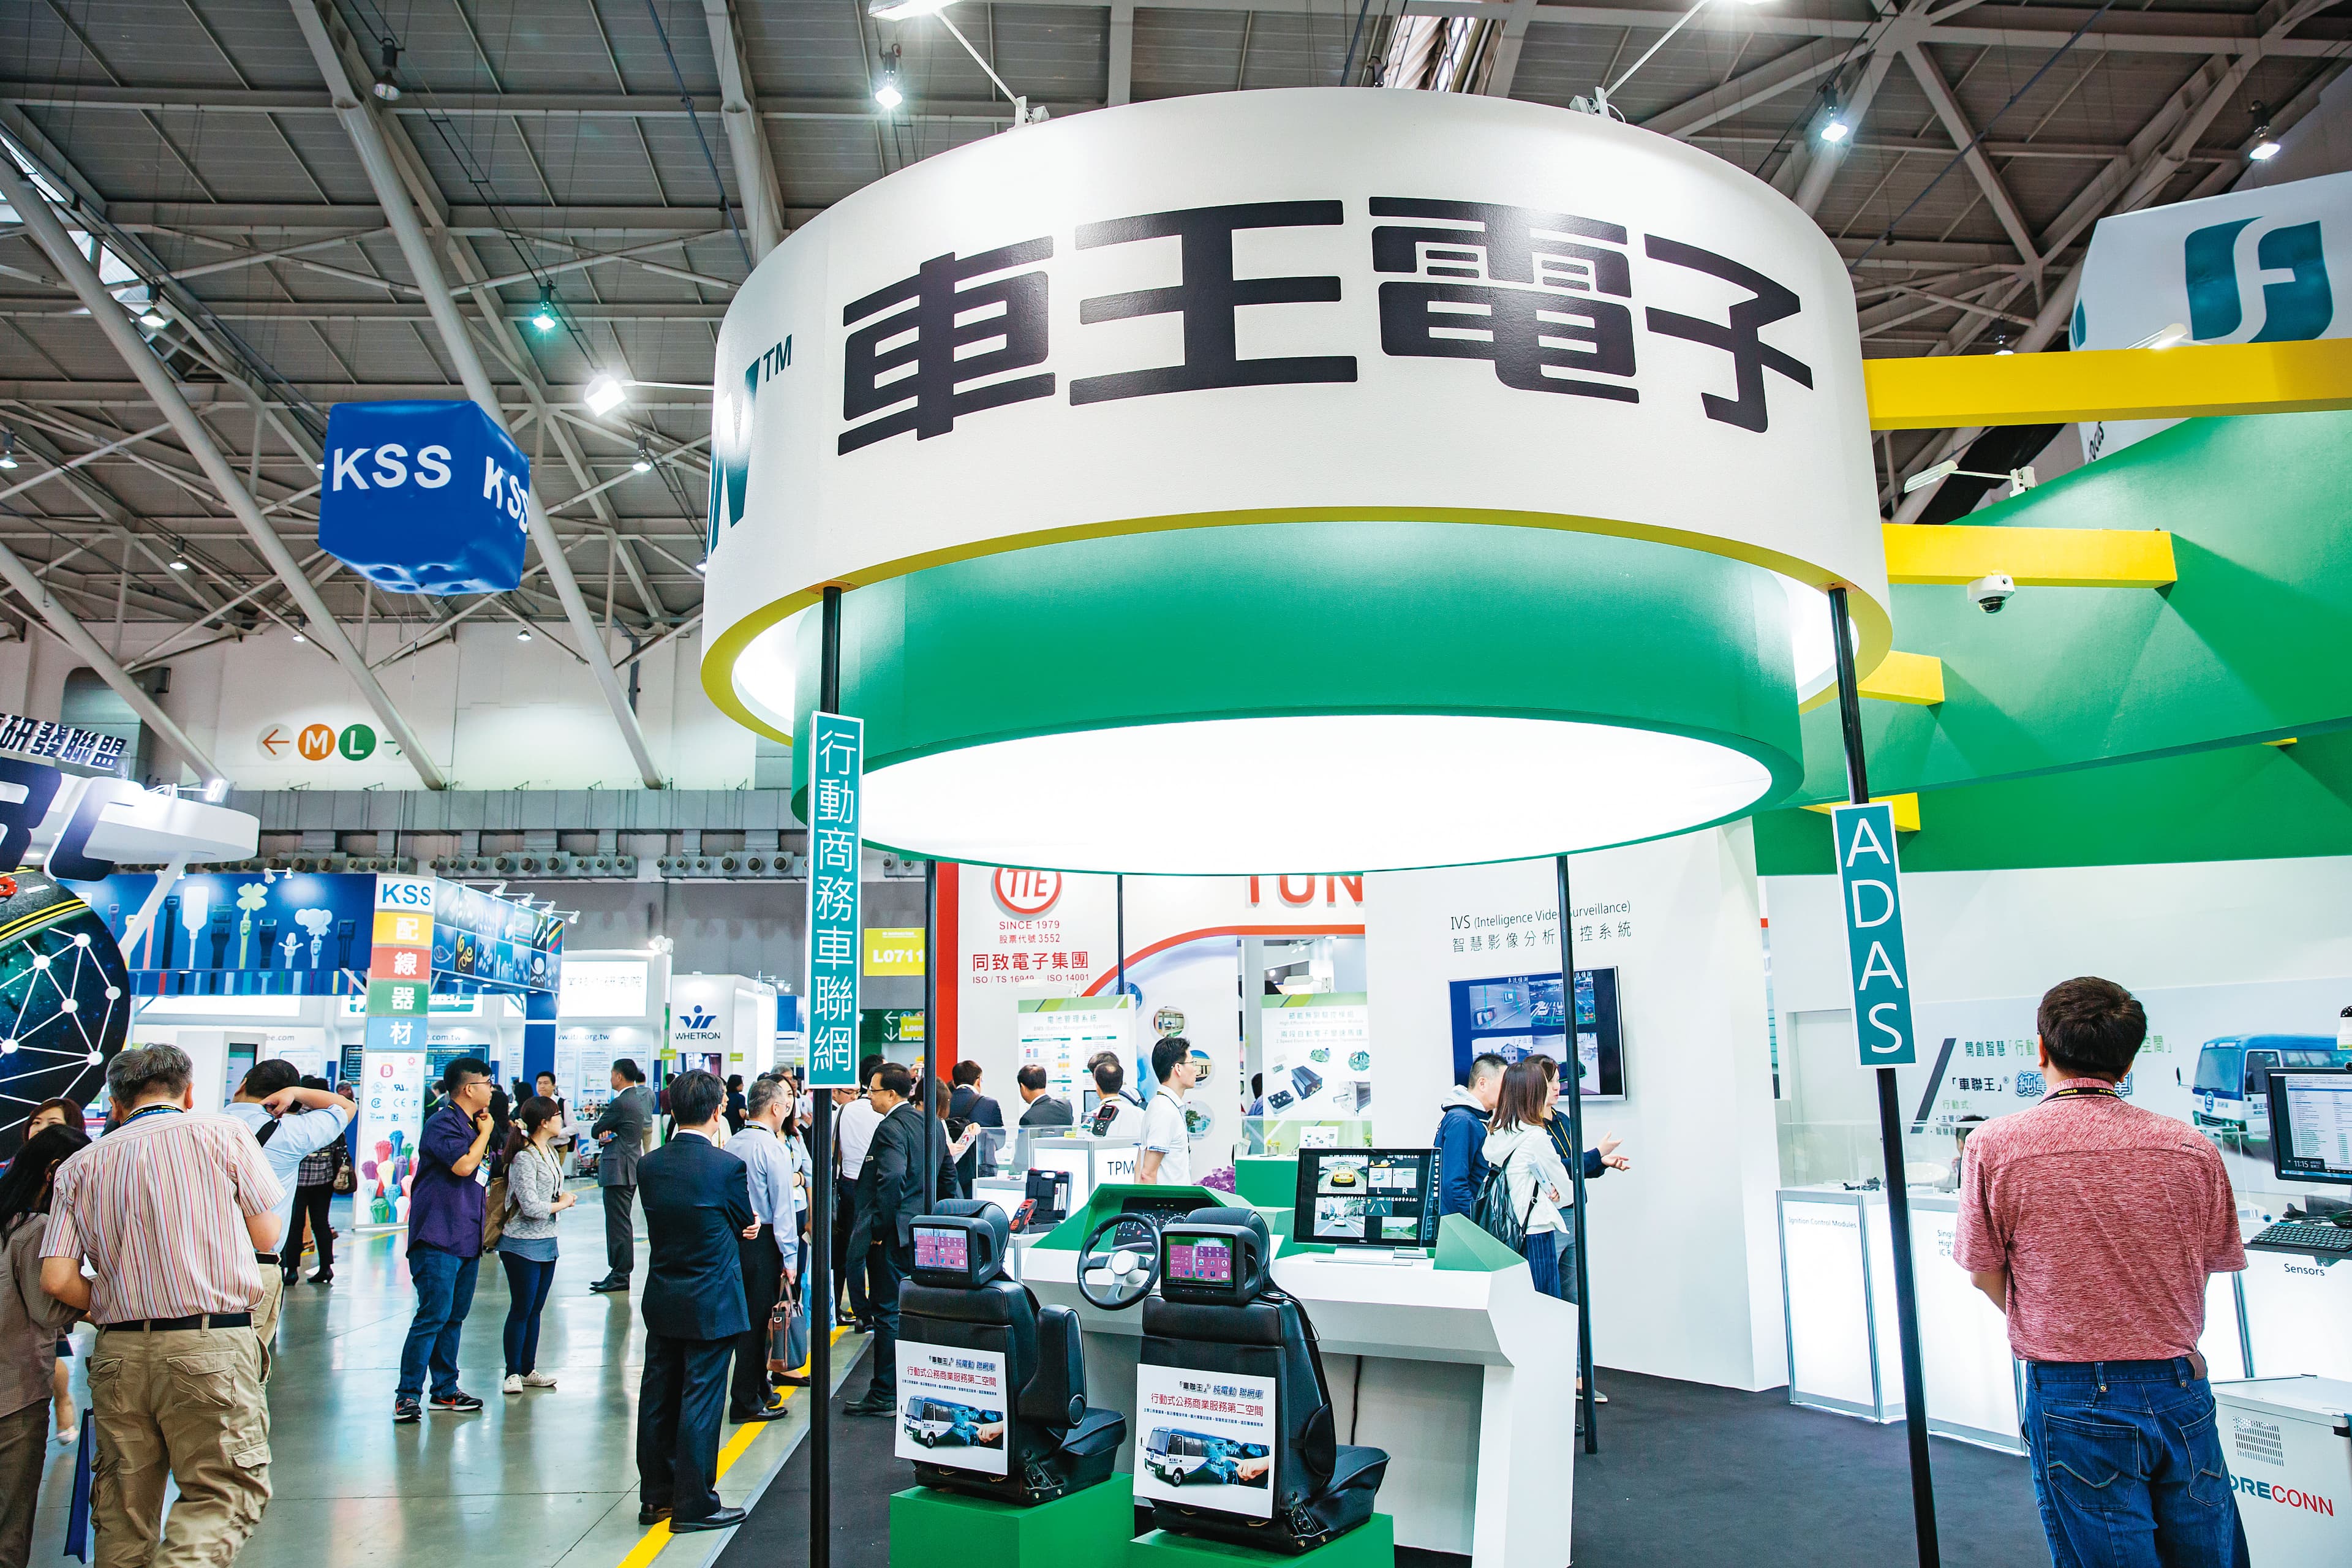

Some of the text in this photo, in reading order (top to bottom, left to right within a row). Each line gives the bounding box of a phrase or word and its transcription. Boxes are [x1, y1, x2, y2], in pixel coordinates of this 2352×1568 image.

[837, 196, 1814, 456] 車王電子
[333, 443, 451, 491] KSS
[483, 456, 529, 533] KSS
[306, 730, 367, 755] M L
[382, 883, 431, 905] KSS
[813, 729, 857, 1072] 行動商務車聯網
[999, 921, 1060, 930] SINCE 1979
[1450, 915, 1470, 930] IVS
[1474, 913, 1532, 930] (Intelligence
[1570, 900, 1630, 919] urveillance)
[1000, 933, 1060, 944] 股票代號 3552
[1453, 921, 1632, 953] 智慧影像分析控系統
[1845, 818, 1904, 1054] ADAS
[873, 949, 924, 963] L0711
[973, 951, 1088, 971] 同致電子集團
[390, 917, 419, 1045] 配線器材
[1107, 1161, 1134, 1175] TPM
[1789, 1216, 1809, 1225] Ignition
[2284, 1263, 2325, 1276] Sensors
[907, 1366, 997, 1387] 行動式公務商業服務第二空間
[1151, 1393, 1264, 1417] 行動式公務商業服務第二空間
